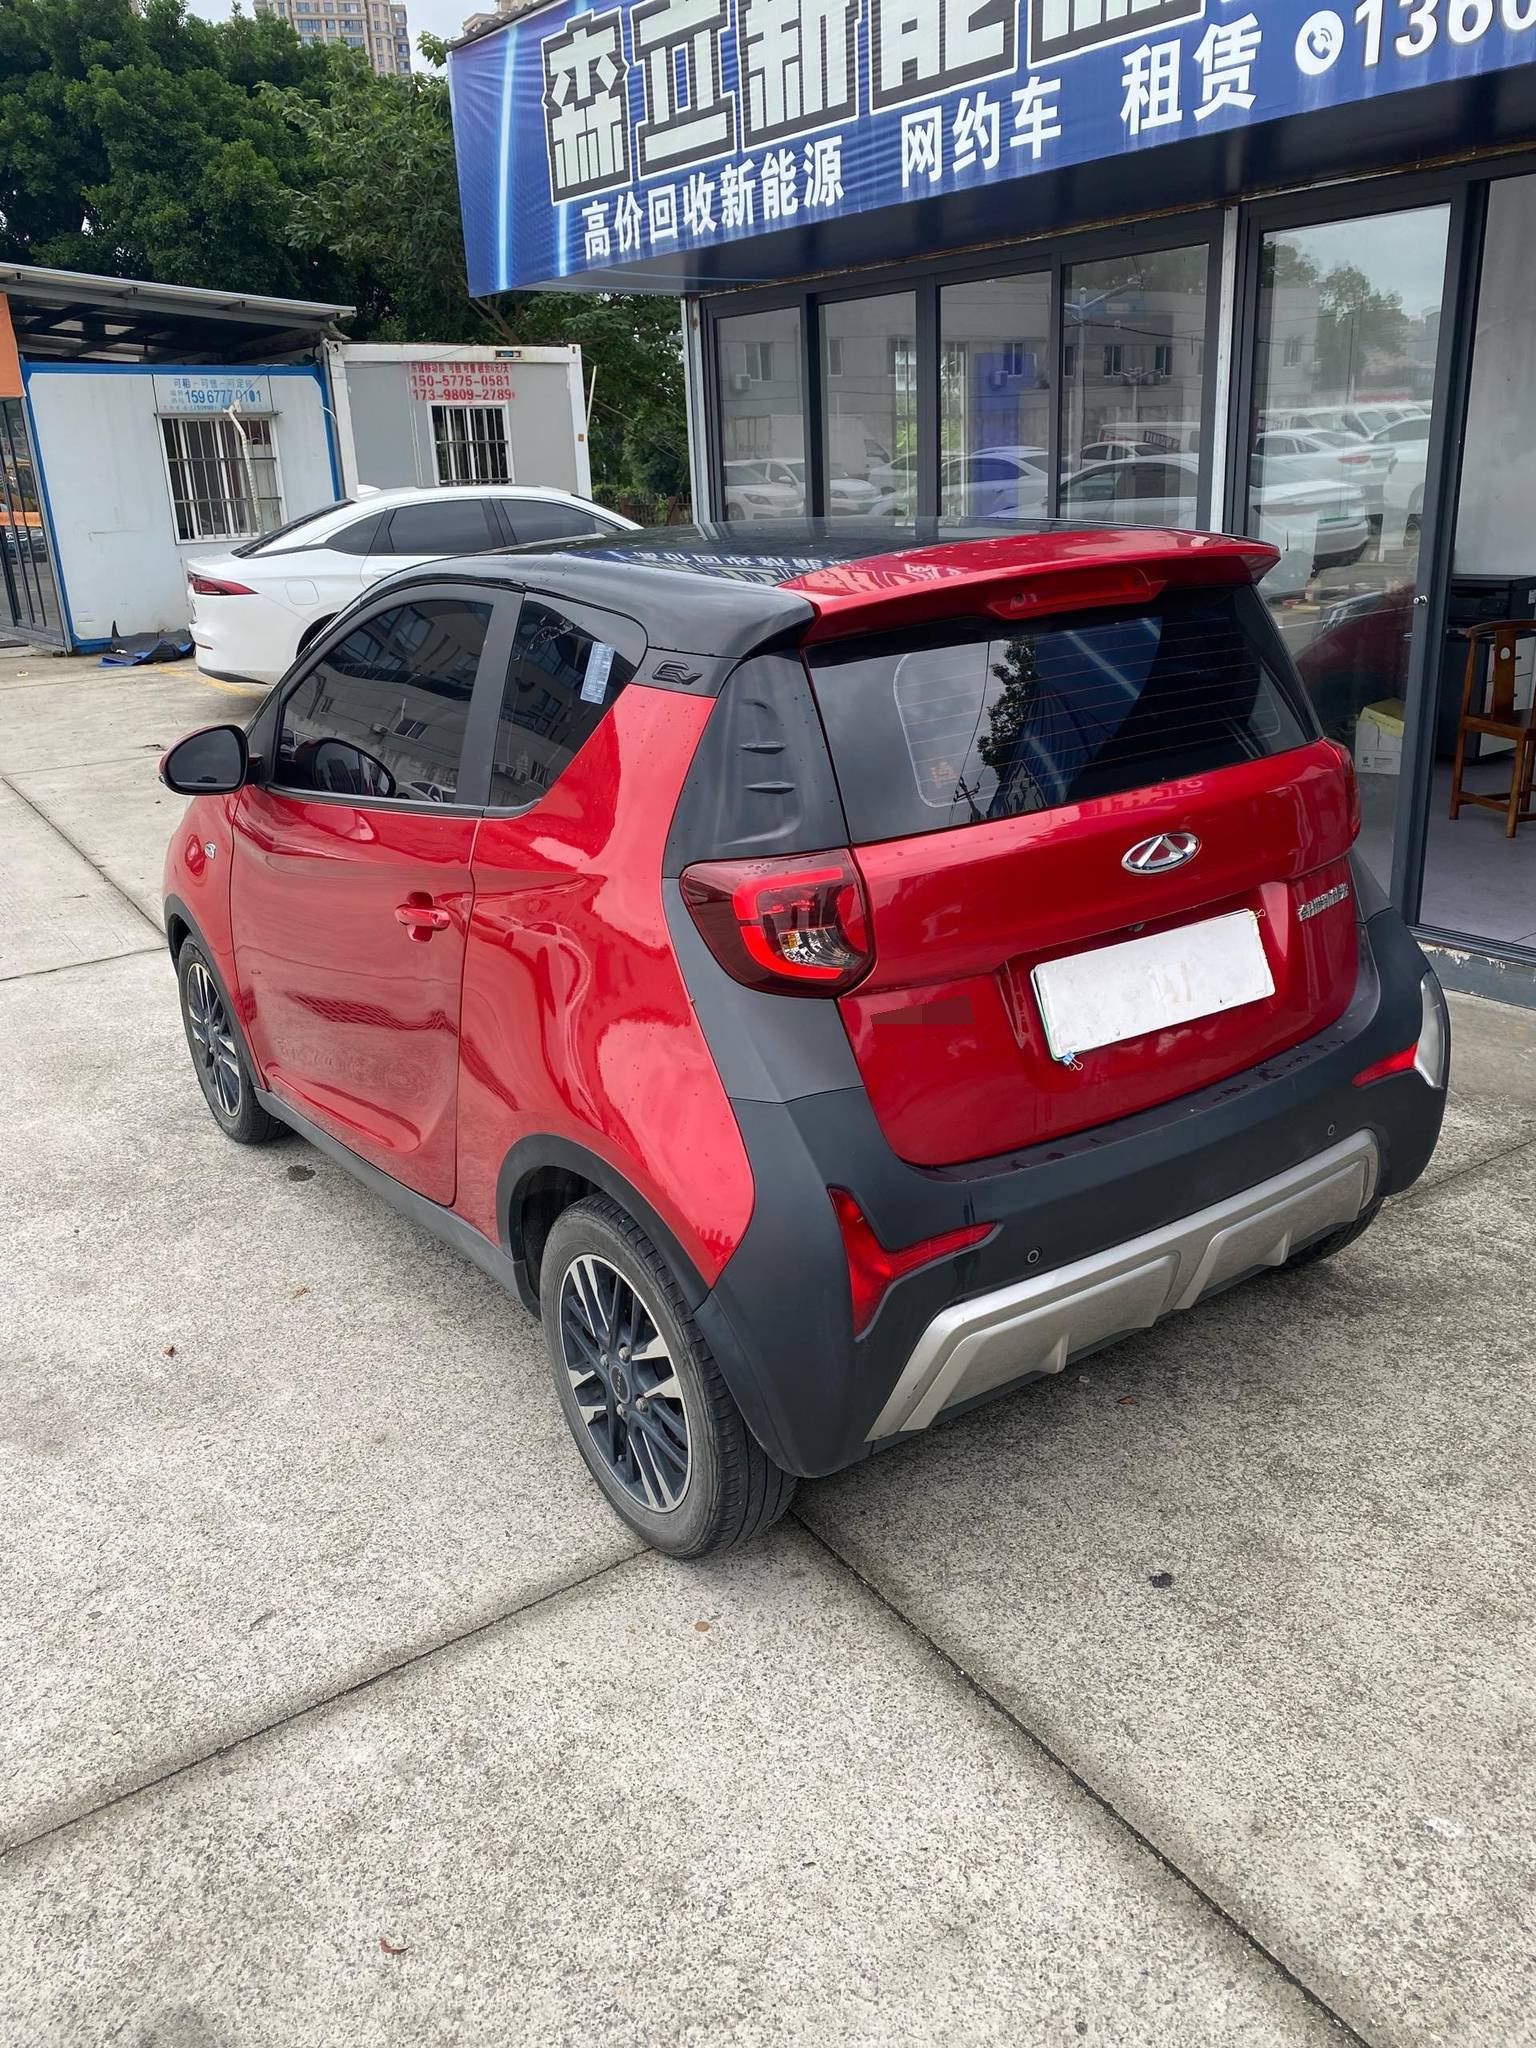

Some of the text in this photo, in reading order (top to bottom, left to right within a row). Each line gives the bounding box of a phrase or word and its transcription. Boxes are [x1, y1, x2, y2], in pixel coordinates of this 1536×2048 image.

[581, 135, 844, 260] 高价回收新能源
[900, 76, 1063, 188] 网约车
[1120, 13, 1264, 136] 租赁
[412, 375, 510, 387] 150-5775-0581
[413, 388, 512, 400] 173-9809-2789
